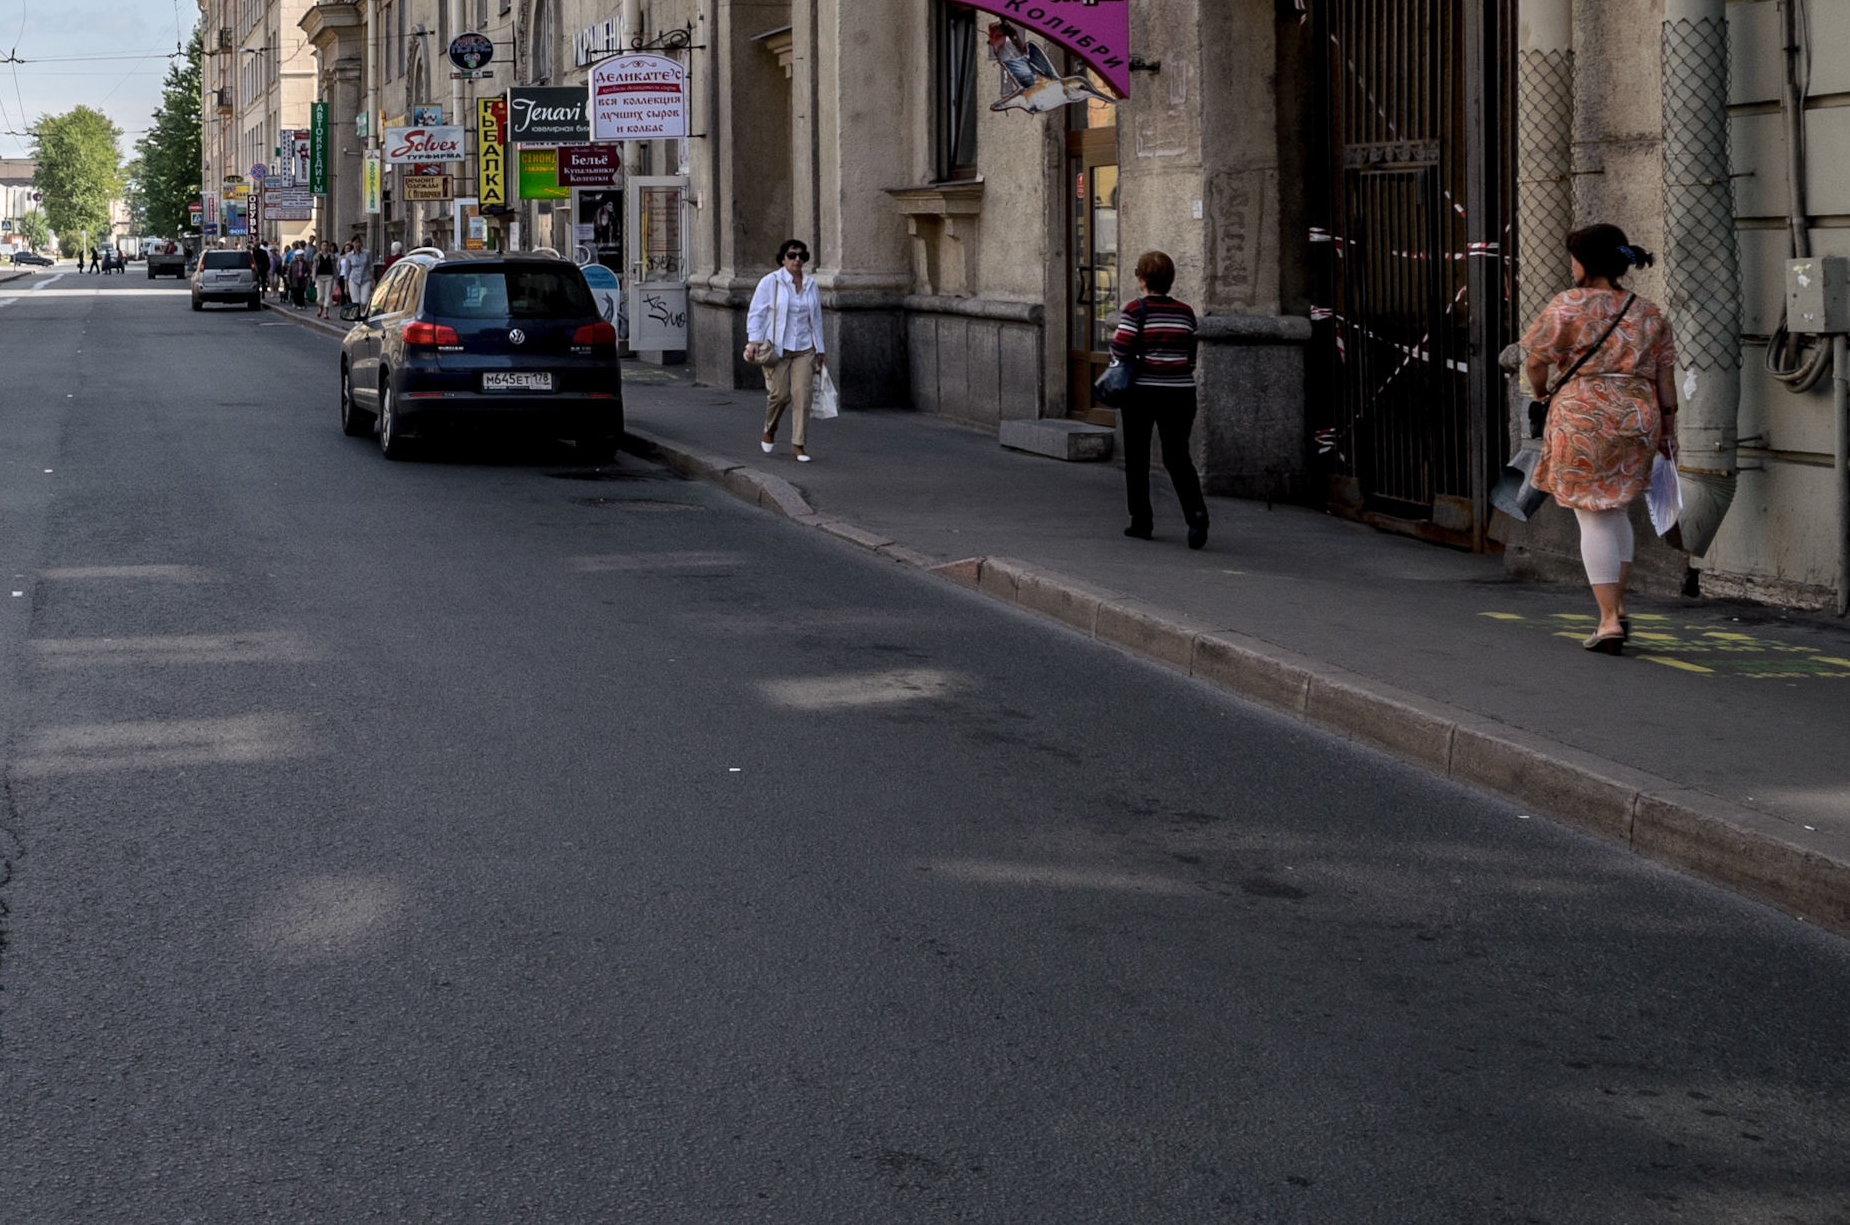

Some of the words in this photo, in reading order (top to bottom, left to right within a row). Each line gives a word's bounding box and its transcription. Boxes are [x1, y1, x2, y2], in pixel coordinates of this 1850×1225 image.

[572, 15, 623, 67] УКРАШЕНИ
[512, 98, 581, 132] Jenavi
[600, 111, 643, 122] лучших
[646, 110, 679, 120] сыров
[531, 125, 574, 133] ювелирная
[627, 124, 663, 133] колбас
[314, 104, 323, 193] АВТОКРЕДИТЫ
[391, 130, 459, 157] Solvex
[571, 155, 608, 165] Бельё
[249, 196, 257, 233] ОБУВЬ
[486, 373, 530, 385] М645ЕТ
[532, 374, 549, 382] 178
